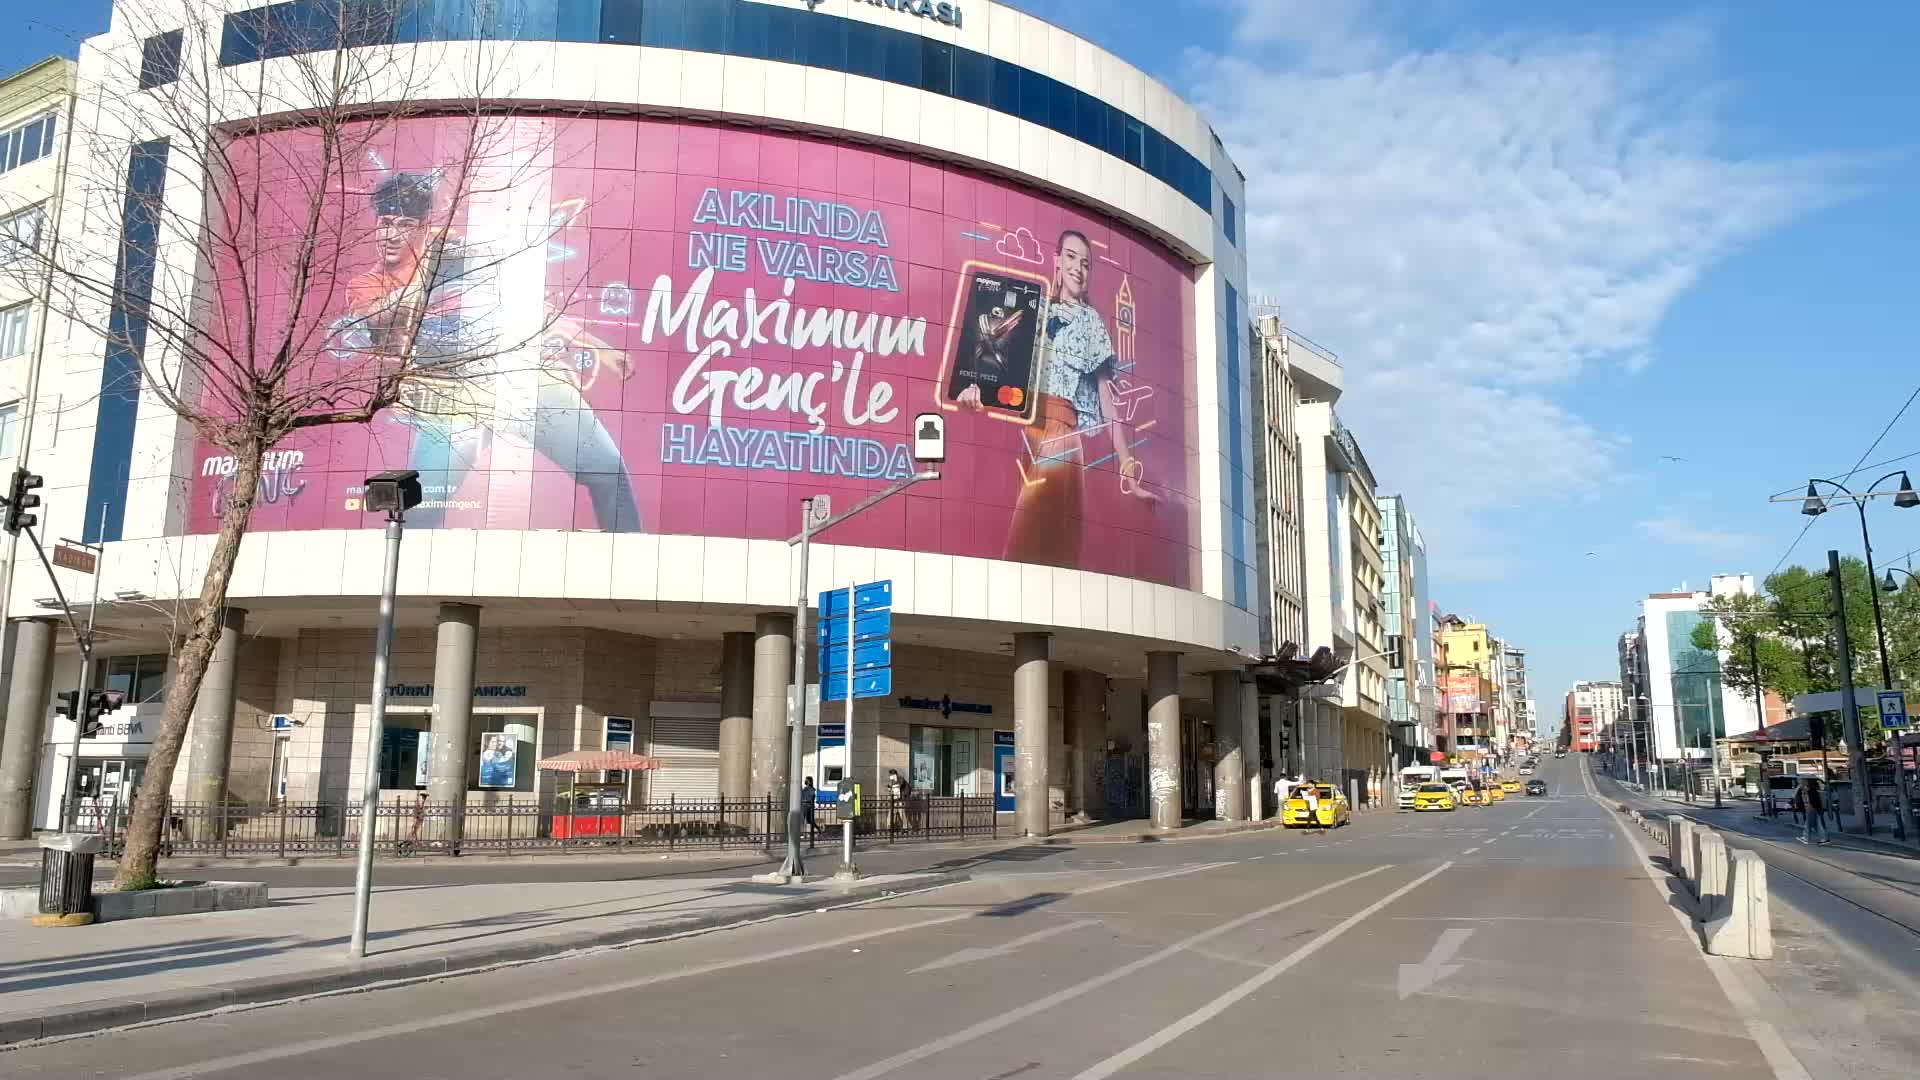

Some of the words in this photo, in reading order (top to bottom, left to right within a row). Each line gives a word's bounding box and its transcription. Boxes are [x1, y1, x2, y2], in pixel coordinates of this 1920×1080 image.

[692, 187, 889, 248] AKLINDA
[688, 230, 747, 273] NE
[756, 237, 899, 292] VARSA
[641, 266, 928, 356] Maximum
[672, 340, 899, 435] Genç'le
[662, 423, 916, 480] HAYATINDA
[474, 685, 526, 697] ANKASI
